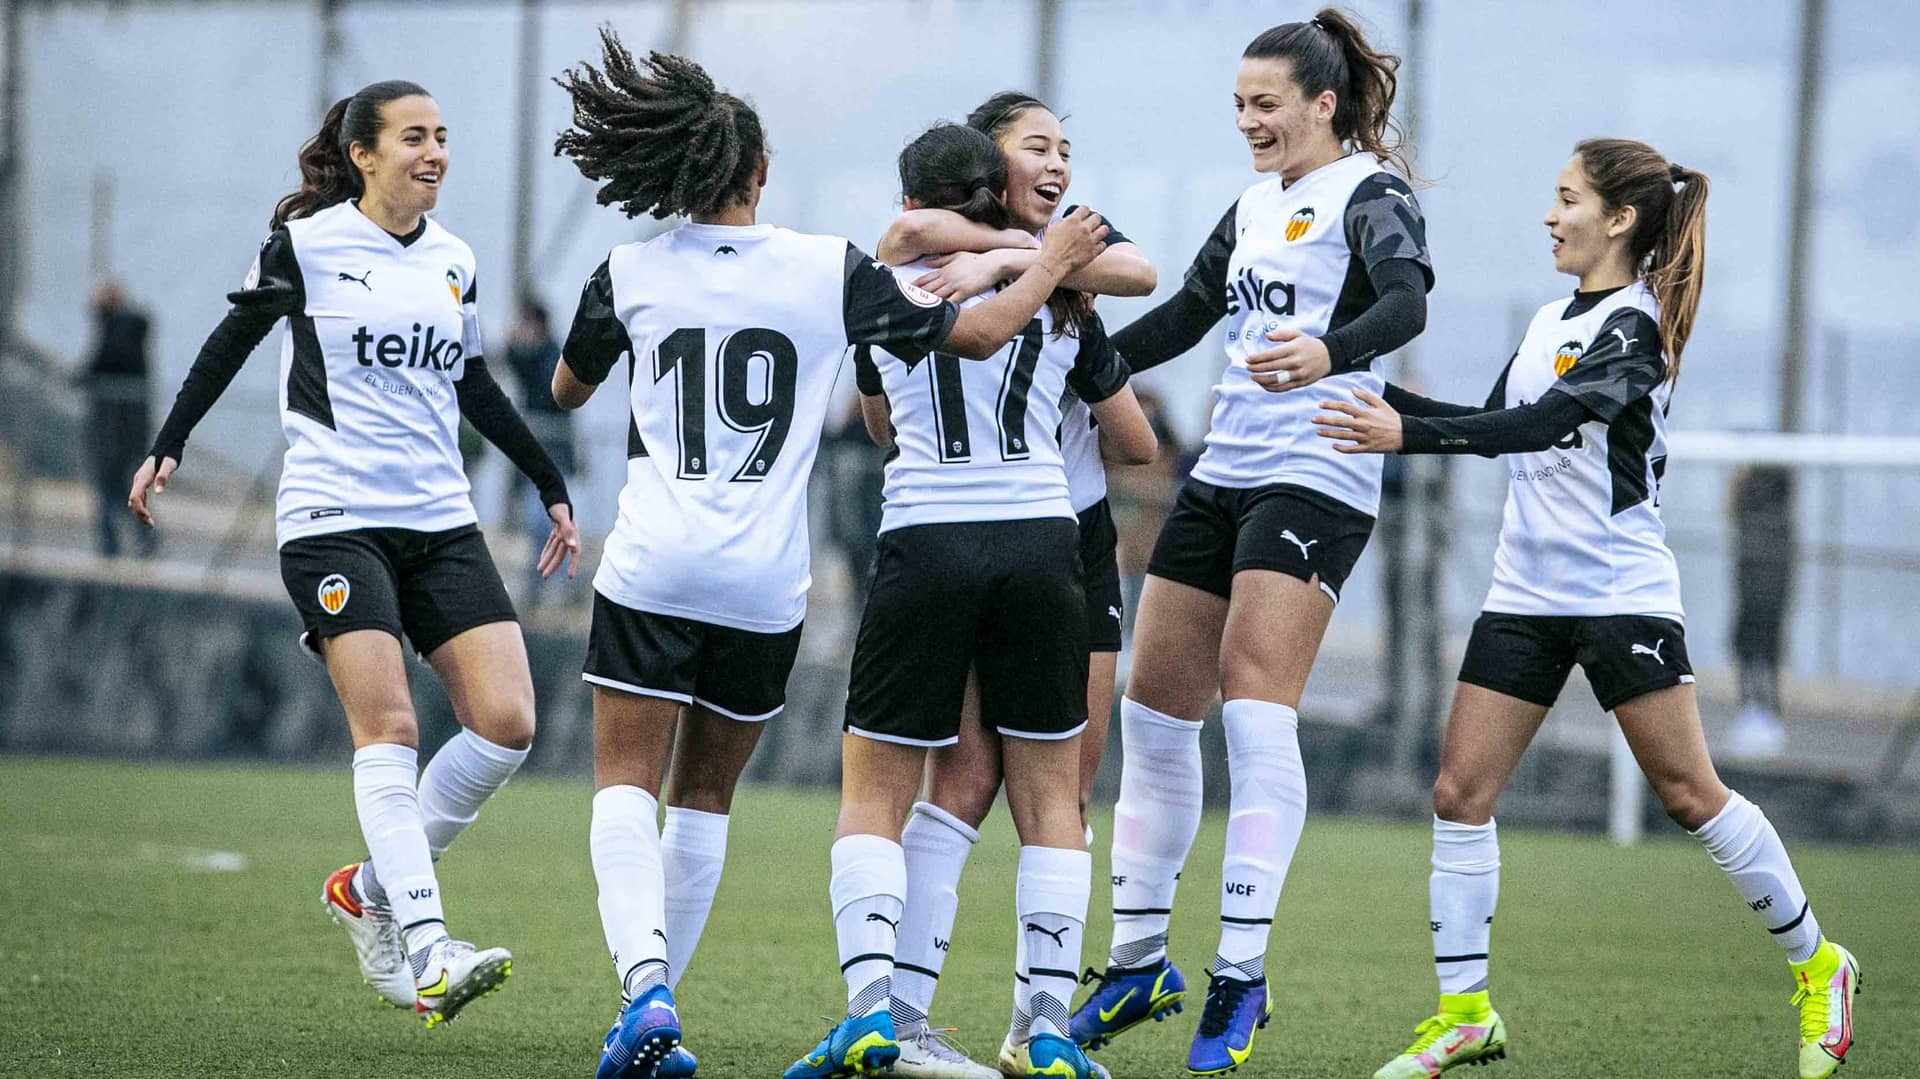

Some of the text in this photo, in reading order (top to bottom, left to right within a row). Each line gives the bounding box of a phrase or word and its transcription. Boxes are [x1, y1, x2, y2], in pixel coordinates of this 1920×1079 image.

[1226, 267, 1296, 317] eika
[383, 384, 414, 397] BUEN
[653, 327, 798, 482] 19
[1530, 456, 1572, 481] VENDING
[1111, 876, 1127, 887] CF
[1225, 882, 1257, 897] VCF
[408, 888, 434, 900] VCF
[1747, 894, 1774, 911] VCF
